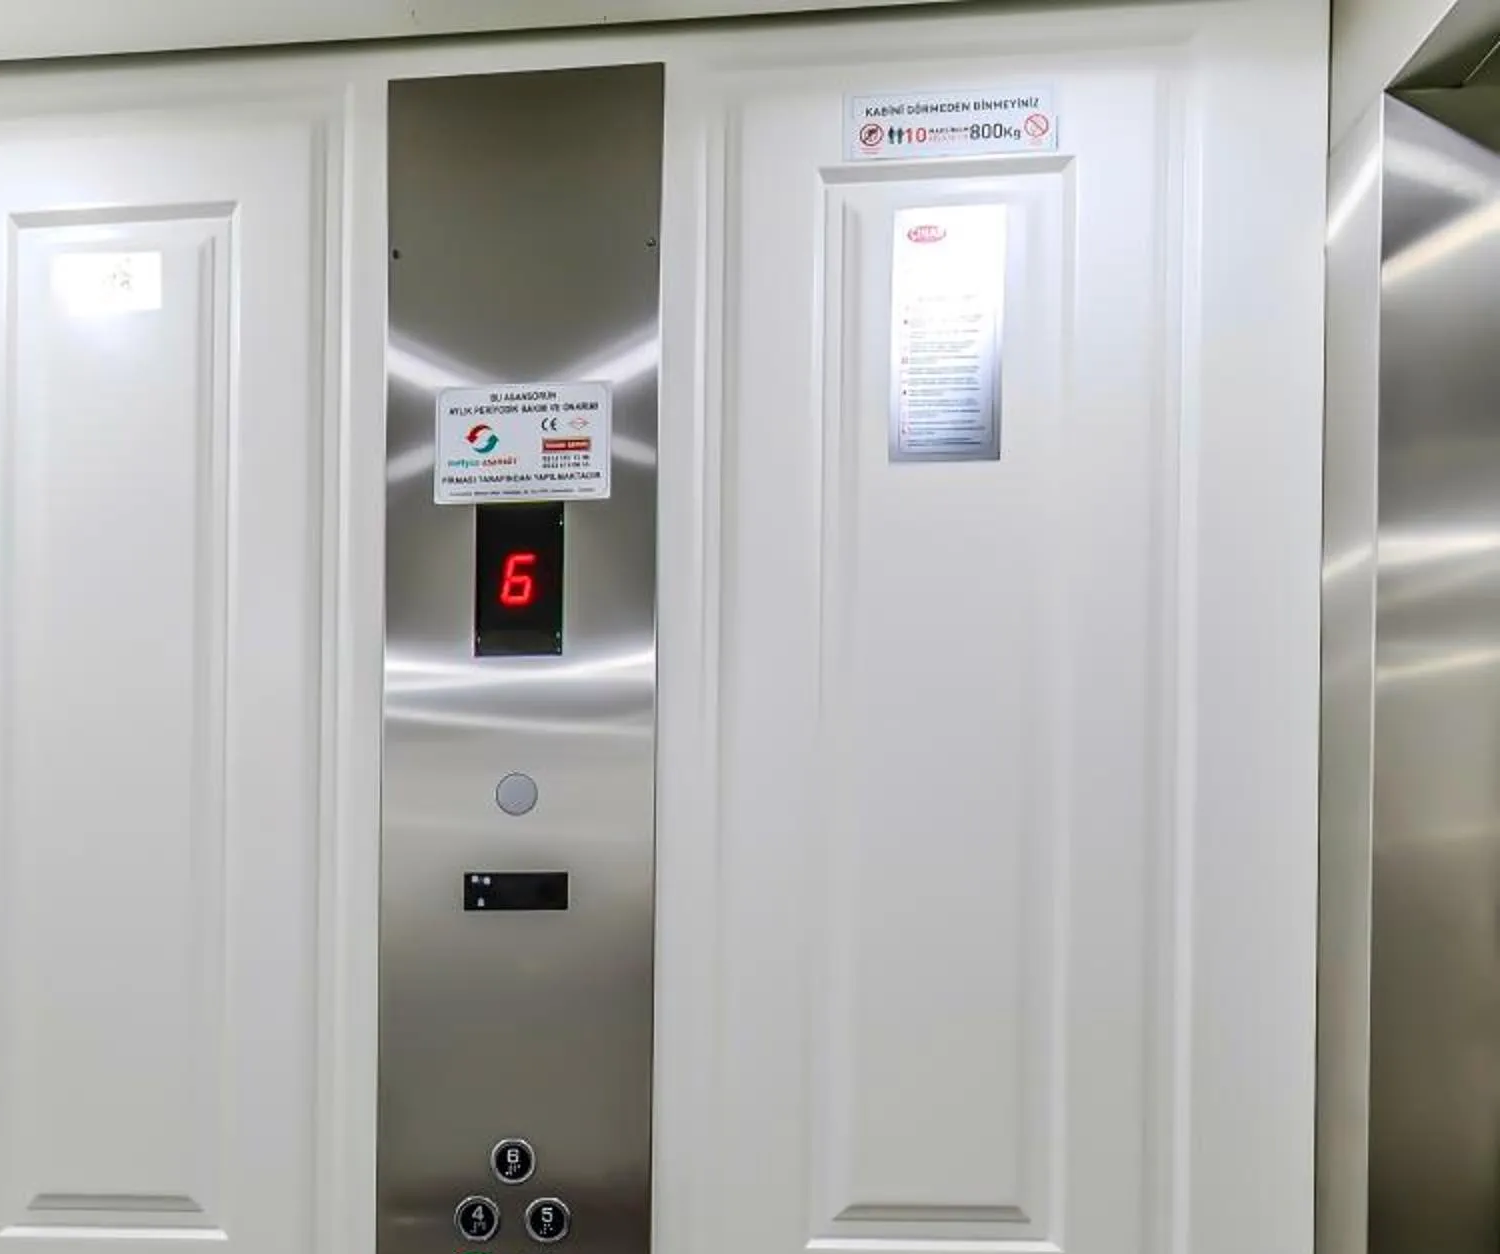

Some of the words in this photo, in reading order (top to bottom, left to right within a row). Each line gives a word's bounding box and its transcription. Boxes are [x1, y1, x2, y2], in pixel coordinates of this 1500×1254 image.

[905, 127, 927, 144] 10
[500, 553, 536, 606] 6
[506, 1149, 519, 1163] 6
[472, 1205, 485, 1220] 4
[541, 1207, 553, 1223] 5
